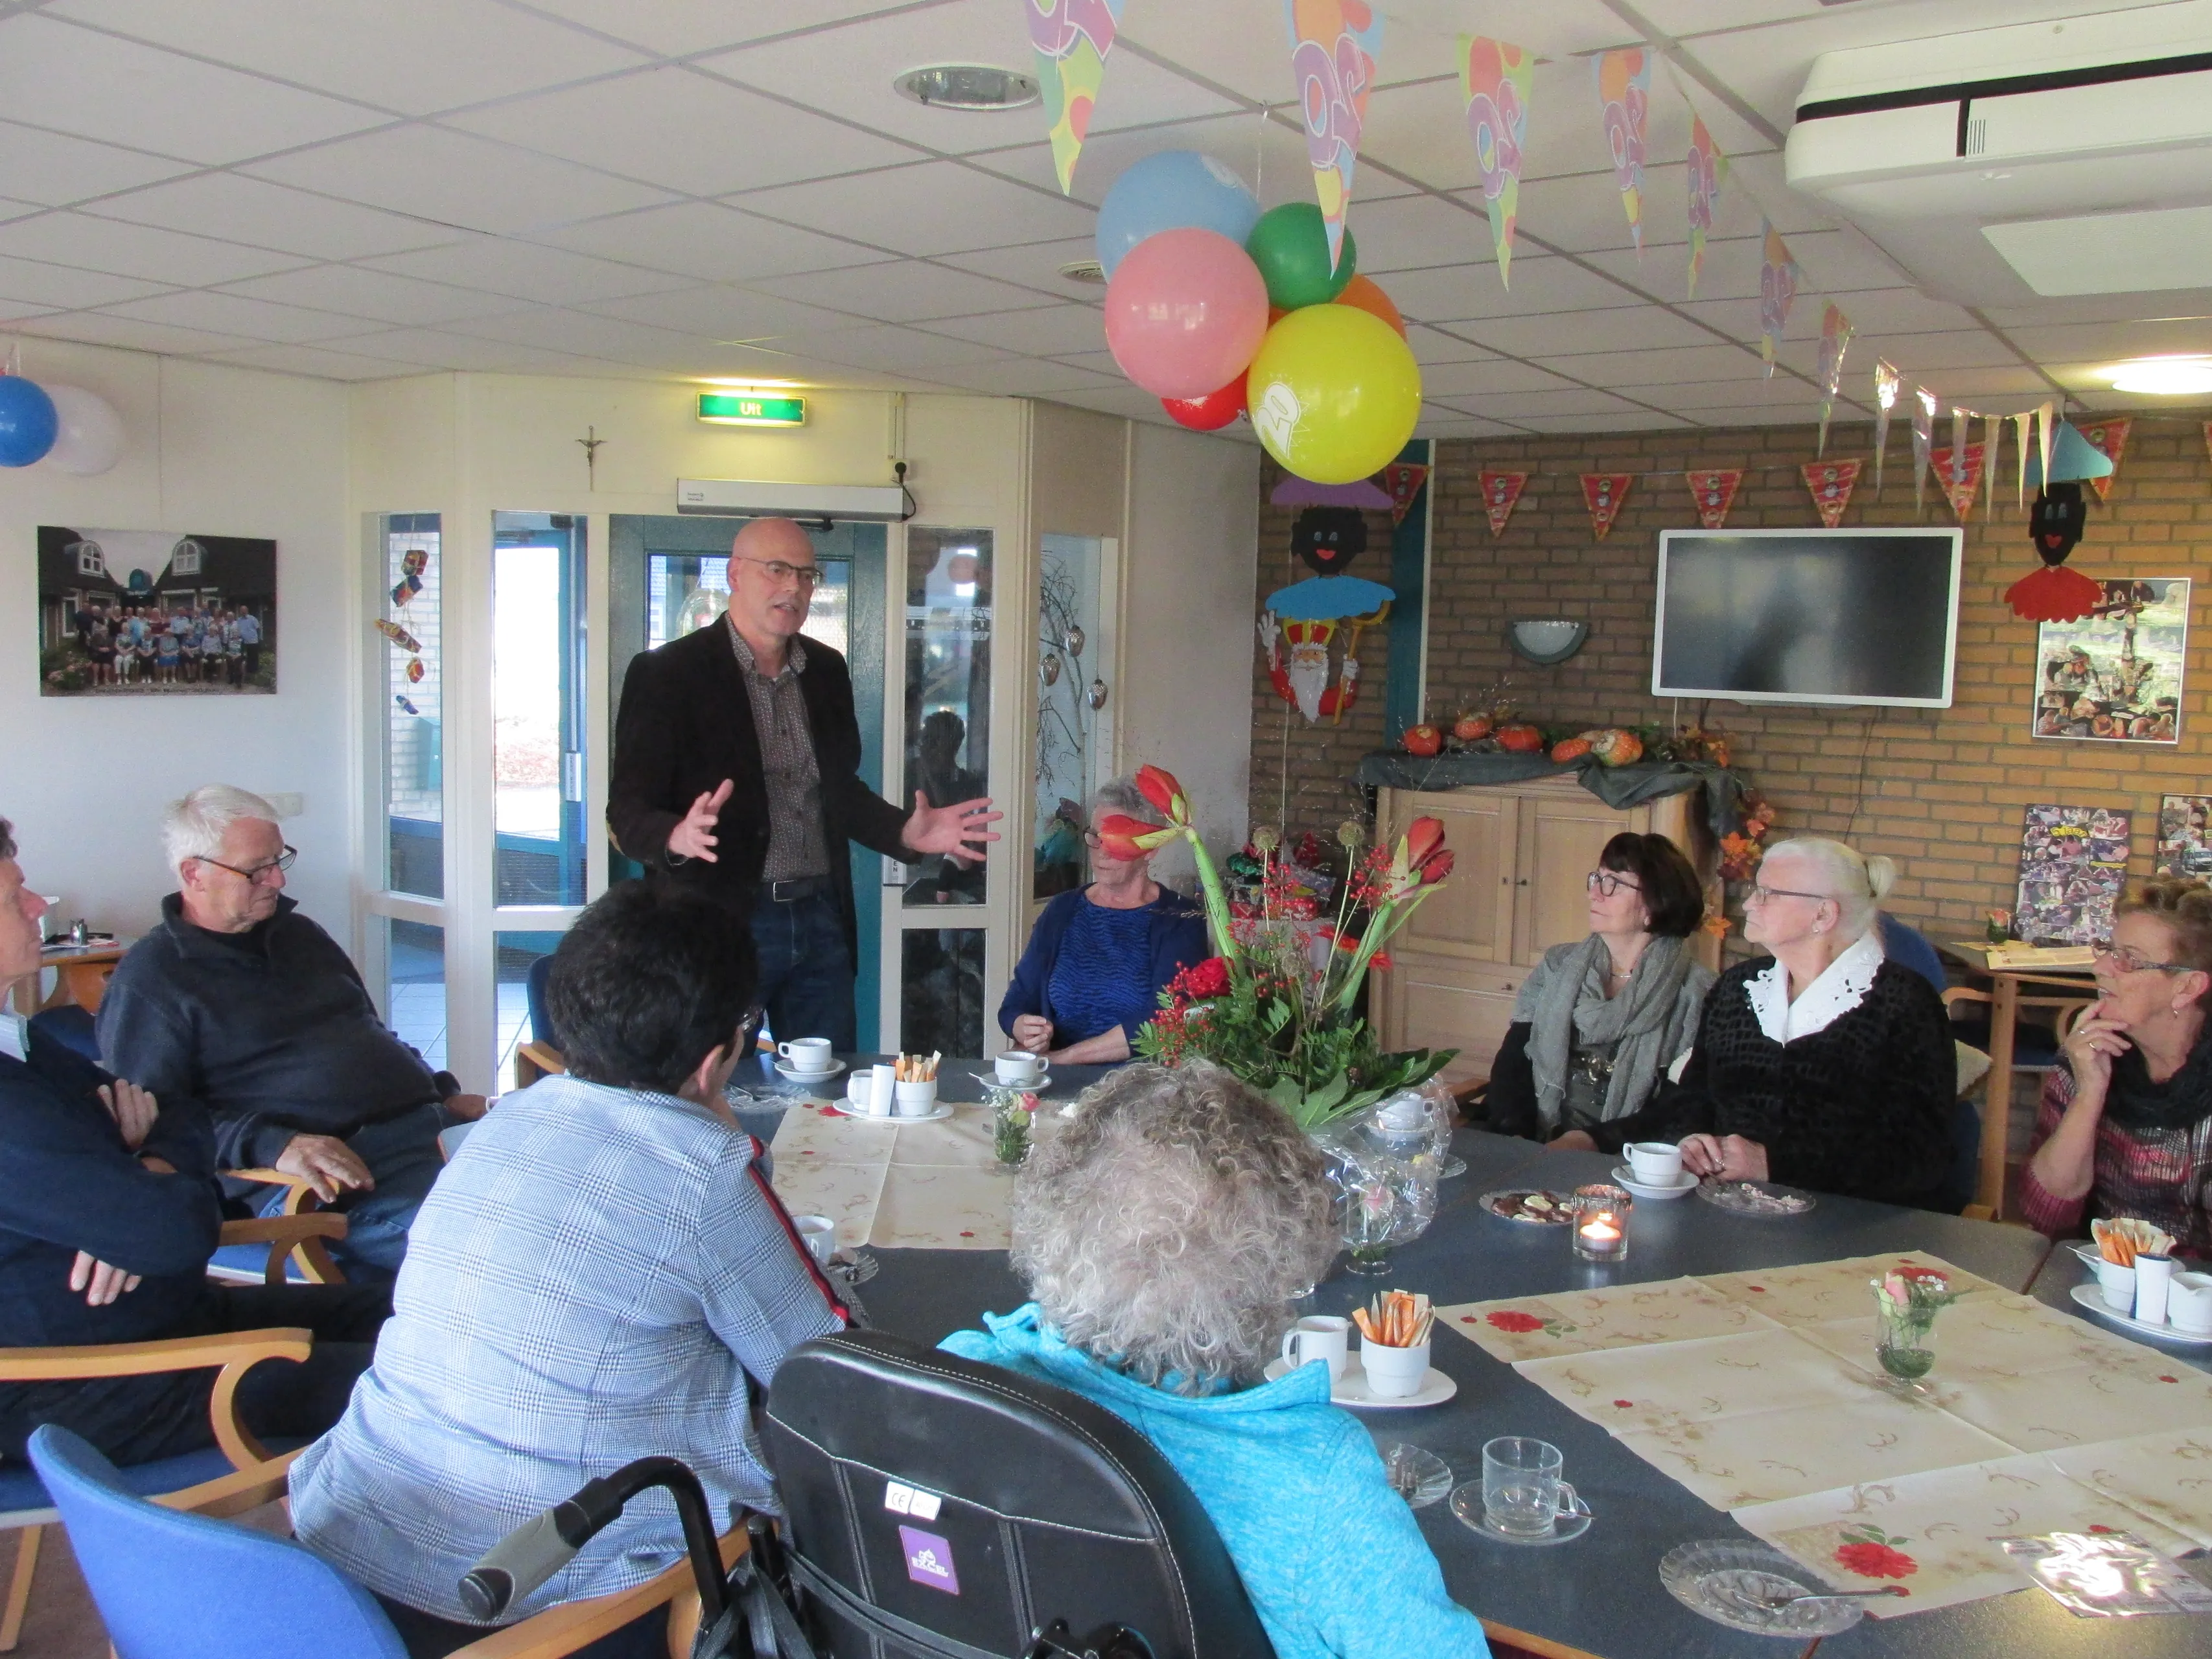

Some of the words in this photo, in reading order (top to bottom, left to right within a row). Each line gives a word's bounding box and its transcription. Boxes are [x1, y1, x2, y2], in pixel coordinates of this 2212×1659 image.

[740, 401, 762, 416] Uit
[1255, 381, 1301, 459] 20
[891, 1492, 906, 1507] CE
